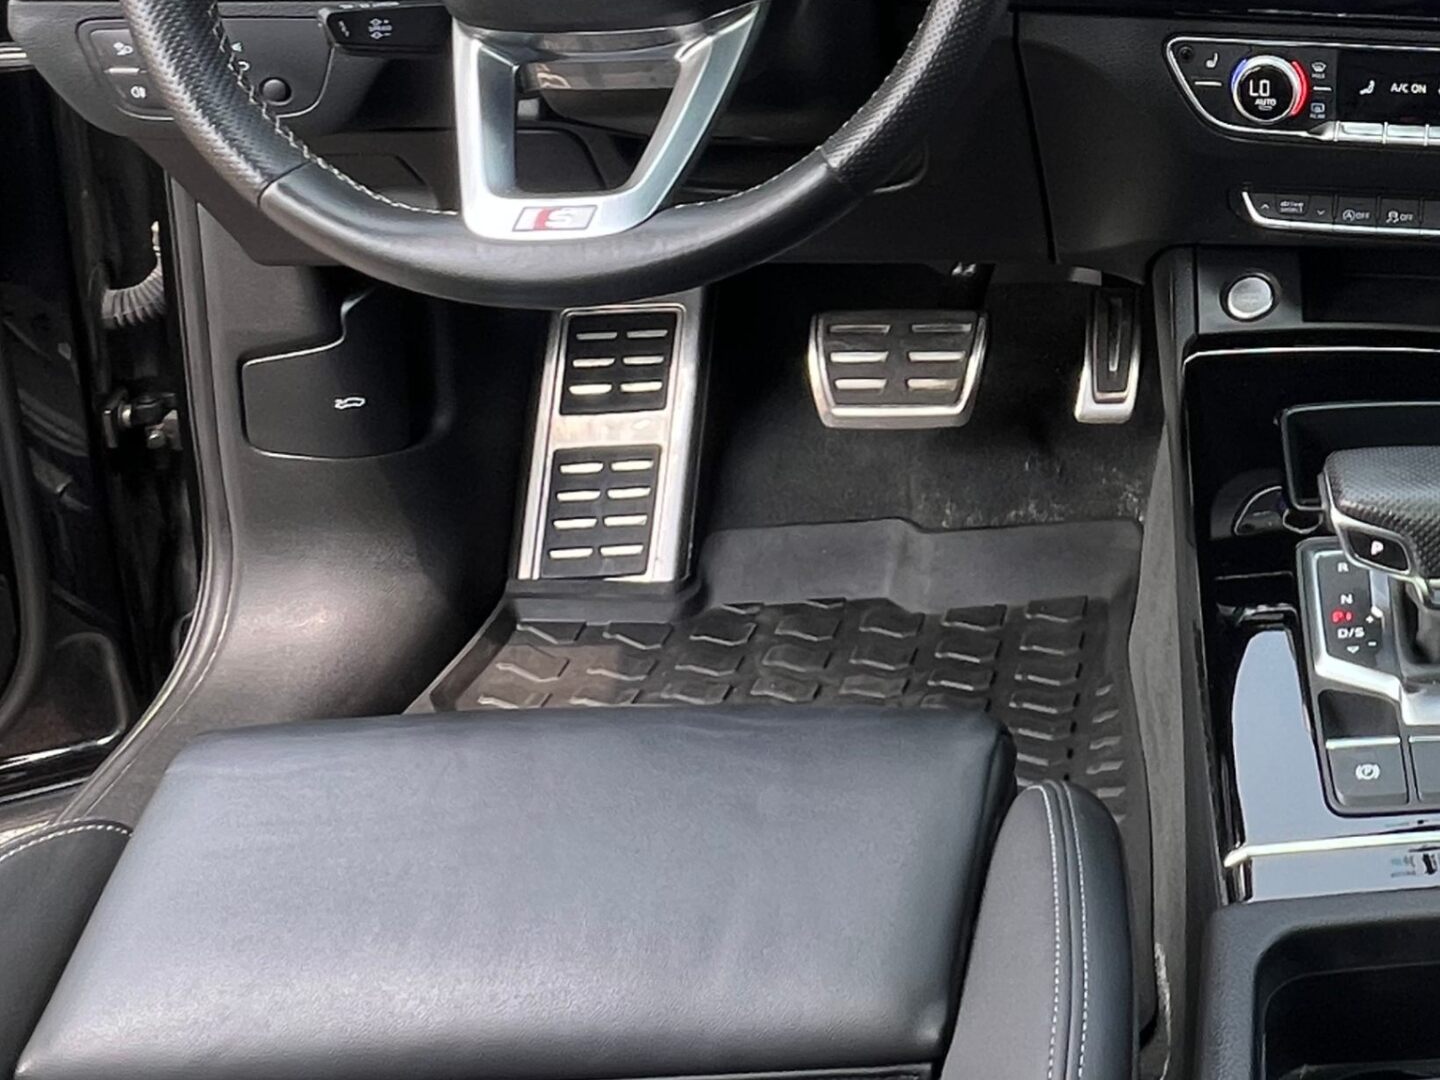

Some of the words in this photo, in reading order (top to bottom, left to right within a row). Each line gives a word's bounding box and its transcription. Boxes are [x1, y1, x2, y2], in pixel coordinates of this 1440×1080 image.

[1390, 83, 1409, 93] A/C
[1411, 83, 1427, 94] ON
[1255, 98, 1277, 106] AUTO
[1371, 540, 1384, 555] P
[1338, 562, 1348, 572] R
[1341, 593, 1353, 604] N
[1337, 627, 1365, 638] D/S
